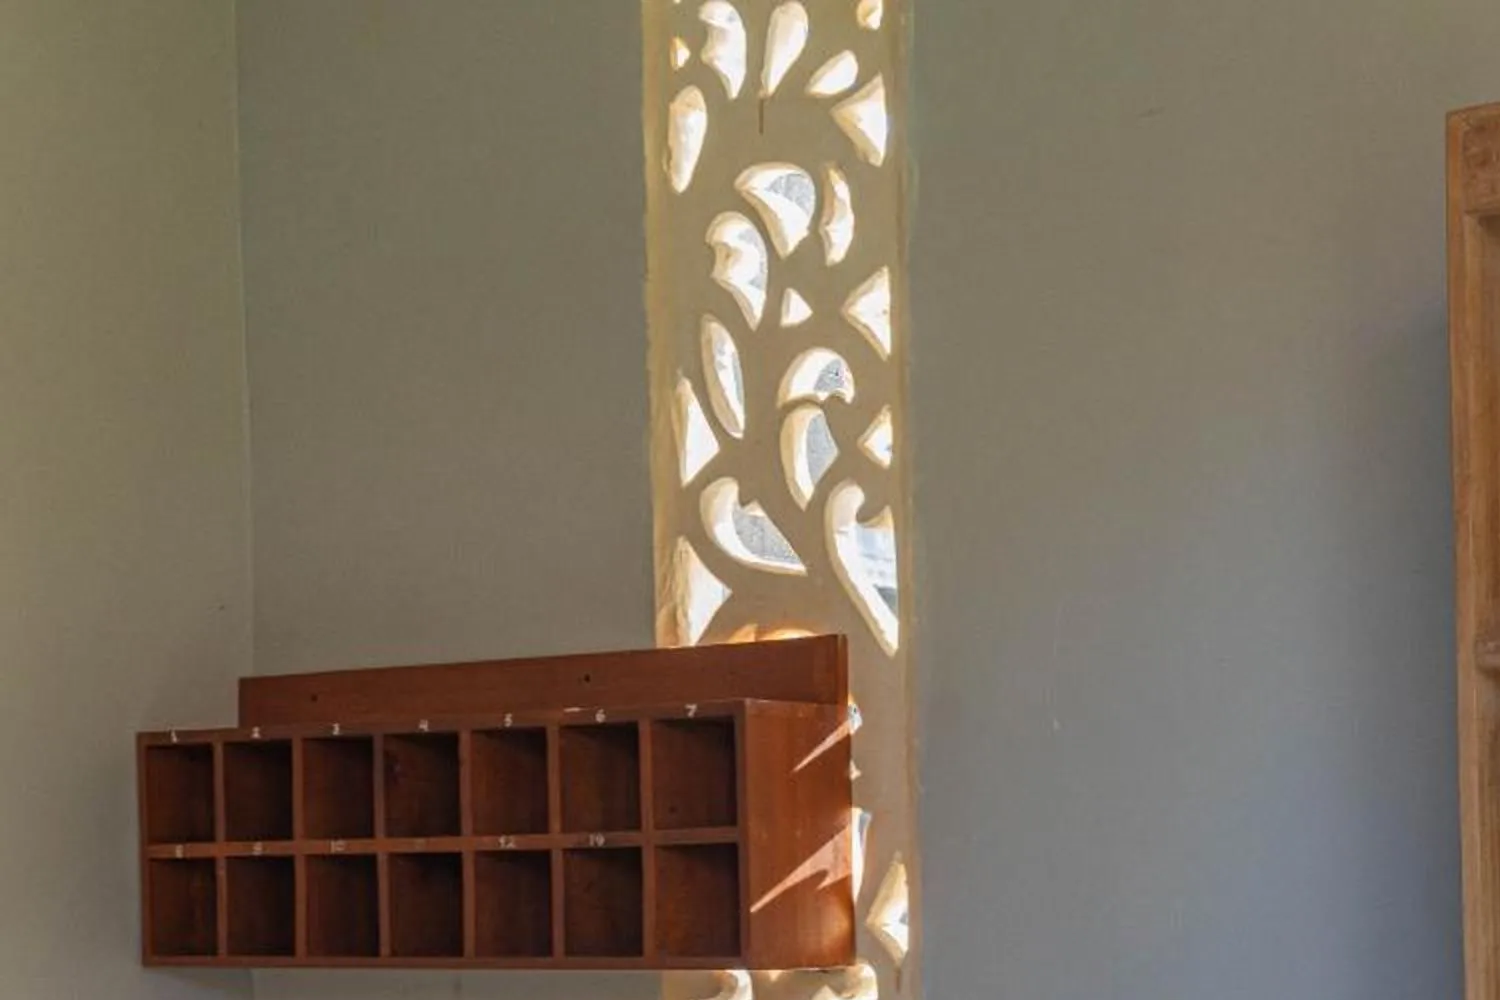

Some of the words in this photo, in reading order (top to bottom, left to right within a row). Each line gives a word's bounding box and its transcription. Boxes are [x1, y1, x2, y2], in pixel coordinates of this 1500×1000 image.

[595, 709, 606, 723] 6
[685, 703, 697, 718] 7
[419, 719, 428, 732] 4
